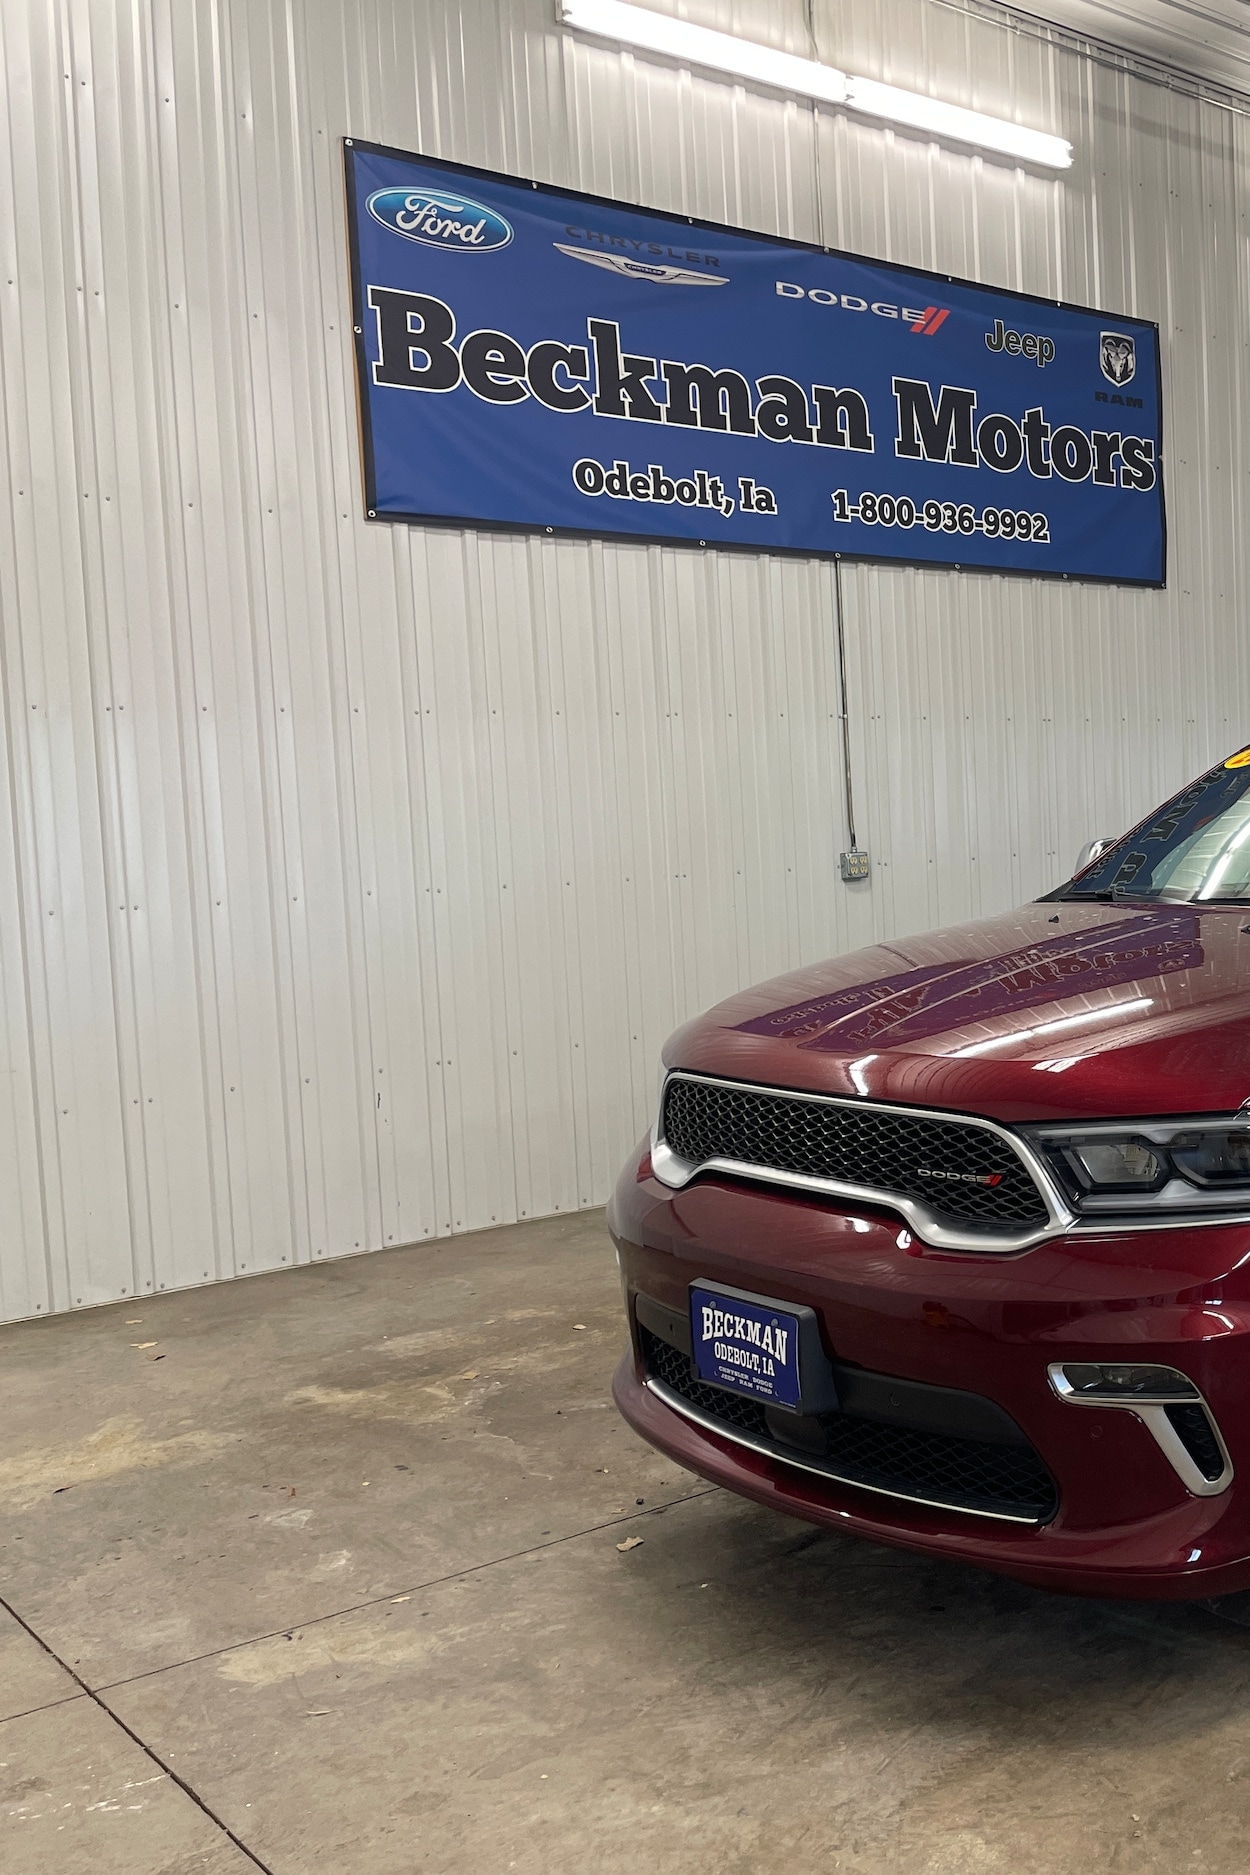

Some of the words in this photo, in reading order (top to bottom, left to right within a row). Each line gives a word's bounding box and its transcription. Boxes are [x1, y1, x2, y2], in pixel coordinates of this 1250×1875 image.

[395, 193, 487, 246] Ford
[565, 226, 721, 268] CHRYSLER
[775, 281, 926, 325] DODGE
[984, 319, 1055, 367] Jeep
[367, 284, 875, 453] Beckman
[892, 376, 1156, 492] Motors
[1094, 390, 1143, 409] RAM
[572, 458, 735, 518] Odebolt,
[738, 477, 777, 515] Ia
[831, 489, 1050, 543] 1-800-936-9992
[917, 1168, 991, 1184] DODGE
[701, 1306, 788, 1366] BECKMAN
[714, 1341, 761, 1374] ODEBOLT,
[762, 1357, 775, 1377] IA
